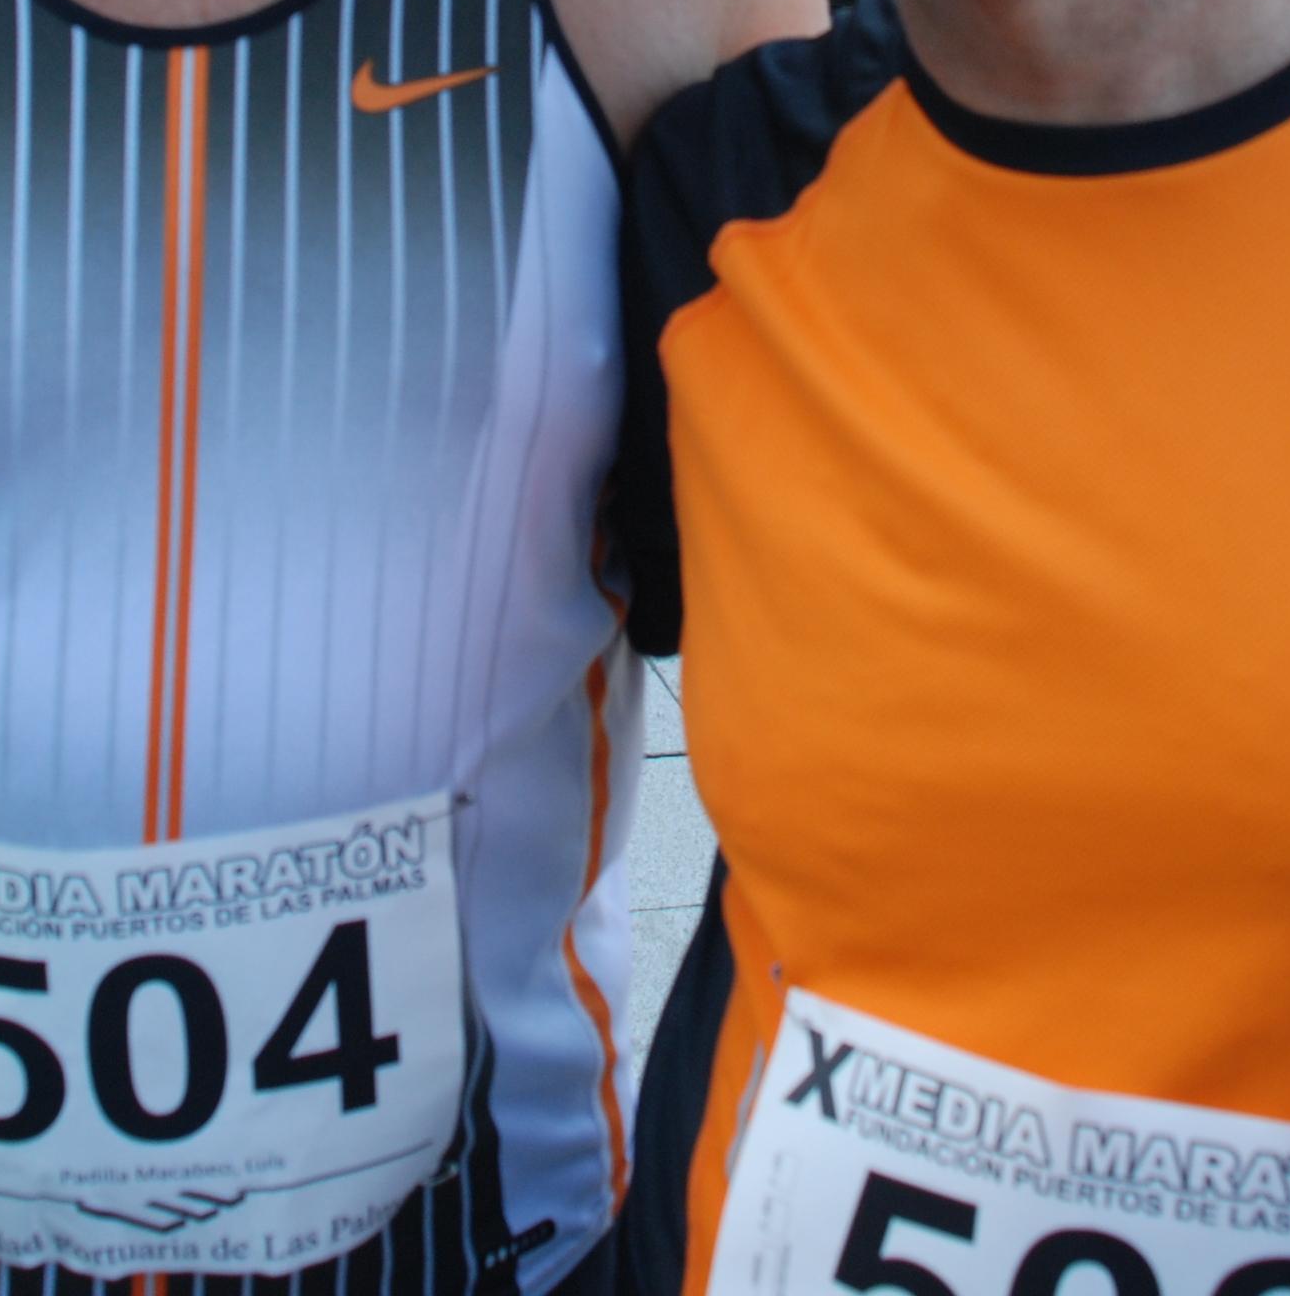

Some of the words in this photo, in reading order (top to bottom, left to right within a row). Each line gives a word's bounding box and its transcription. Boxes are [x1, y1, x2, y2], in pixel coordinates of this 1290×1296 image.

[73, 912, 205, 941] PUERTOS
[215, 904, 254, 928] DE
[262, 892, 313, 920] LAS
[322, 868, 426, 906] PALMAS
[116, 819, 428, 916] MARATÓN
[785, 1029, 854, 1122] X
[849, 1051, 1052, 1168] MEDIA
[845, 1107, 1004, 1182] FUNDACIÓN
[1014, 1166, 1162, 1218] PUERTOS
[1174, 1197, 1220, 1227] DE
[211, 1237, 250, 1261] de
[265, 1230, 318, 1261] Las
